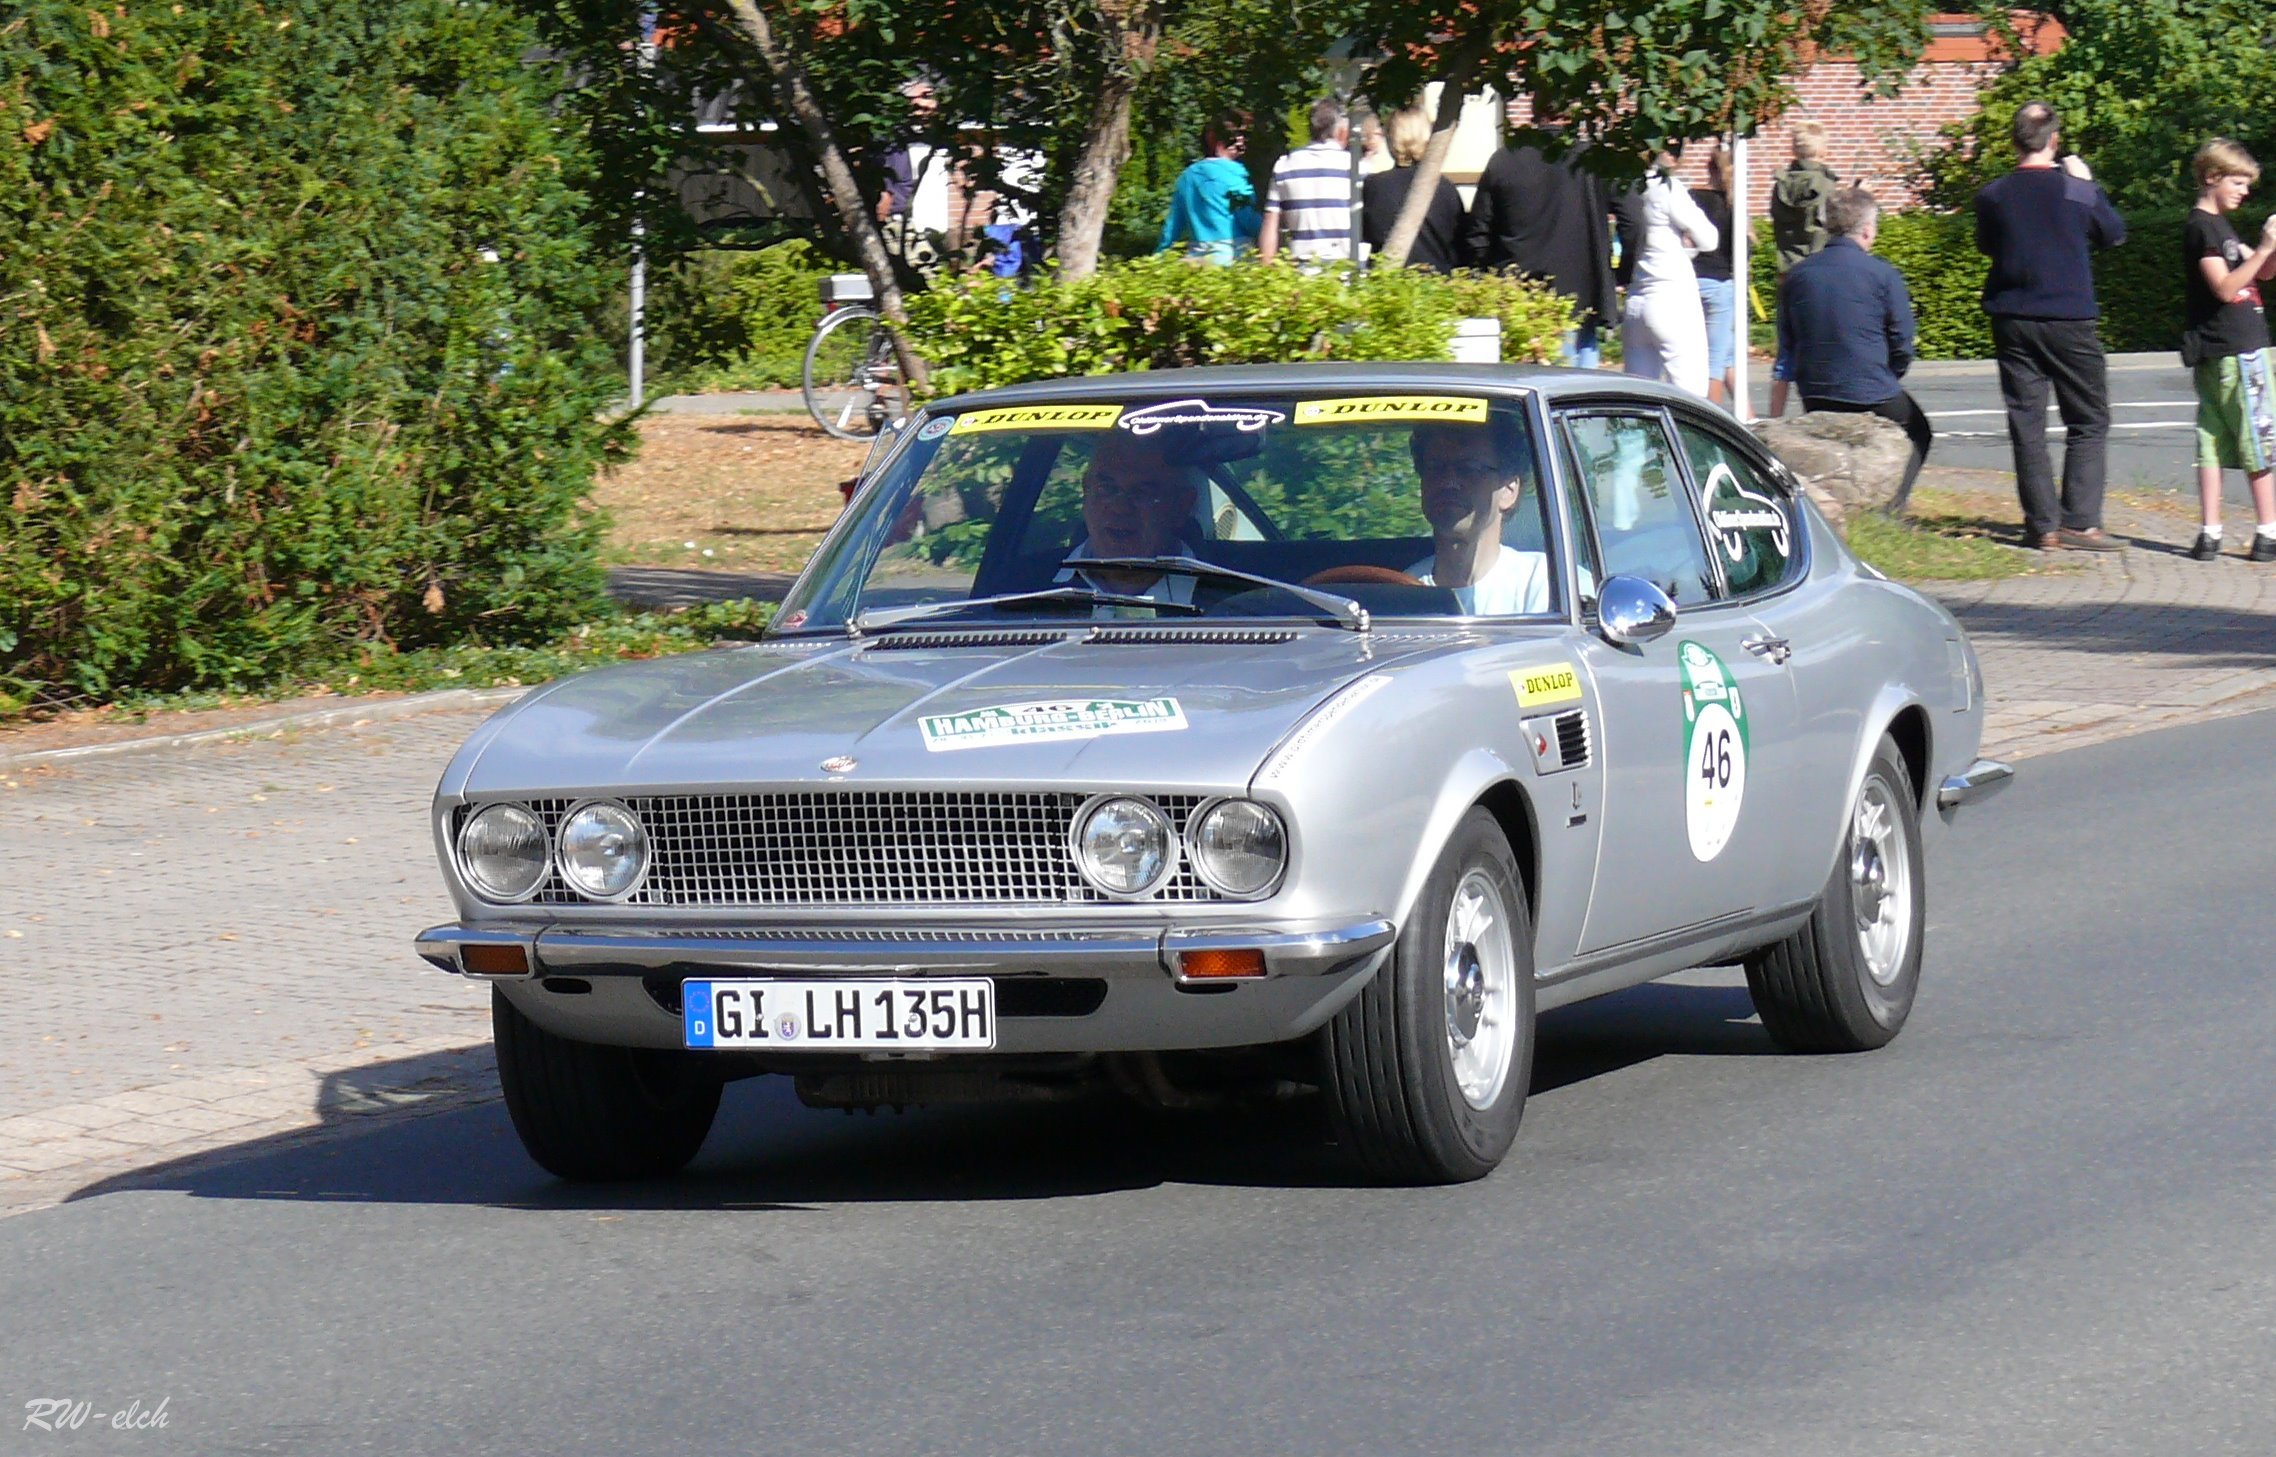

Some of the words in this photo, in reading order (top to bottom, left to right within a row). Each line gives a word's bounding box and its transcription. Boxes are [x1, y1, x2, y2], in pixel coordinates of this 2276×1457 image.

[980, 411, 1113, 424] DUNLOP
[1331, 402, 1479, 415] DUNLOP
[1526, 671, 1573, 694] DUNLOP
[1702, 729, 1731, 789] 46
[716, 990, 769, 1038] GI
[805, 990, 862, 1039] LH
[874, 989, 988, 1039] 135H
[694, 1020, 705, 1035] D
